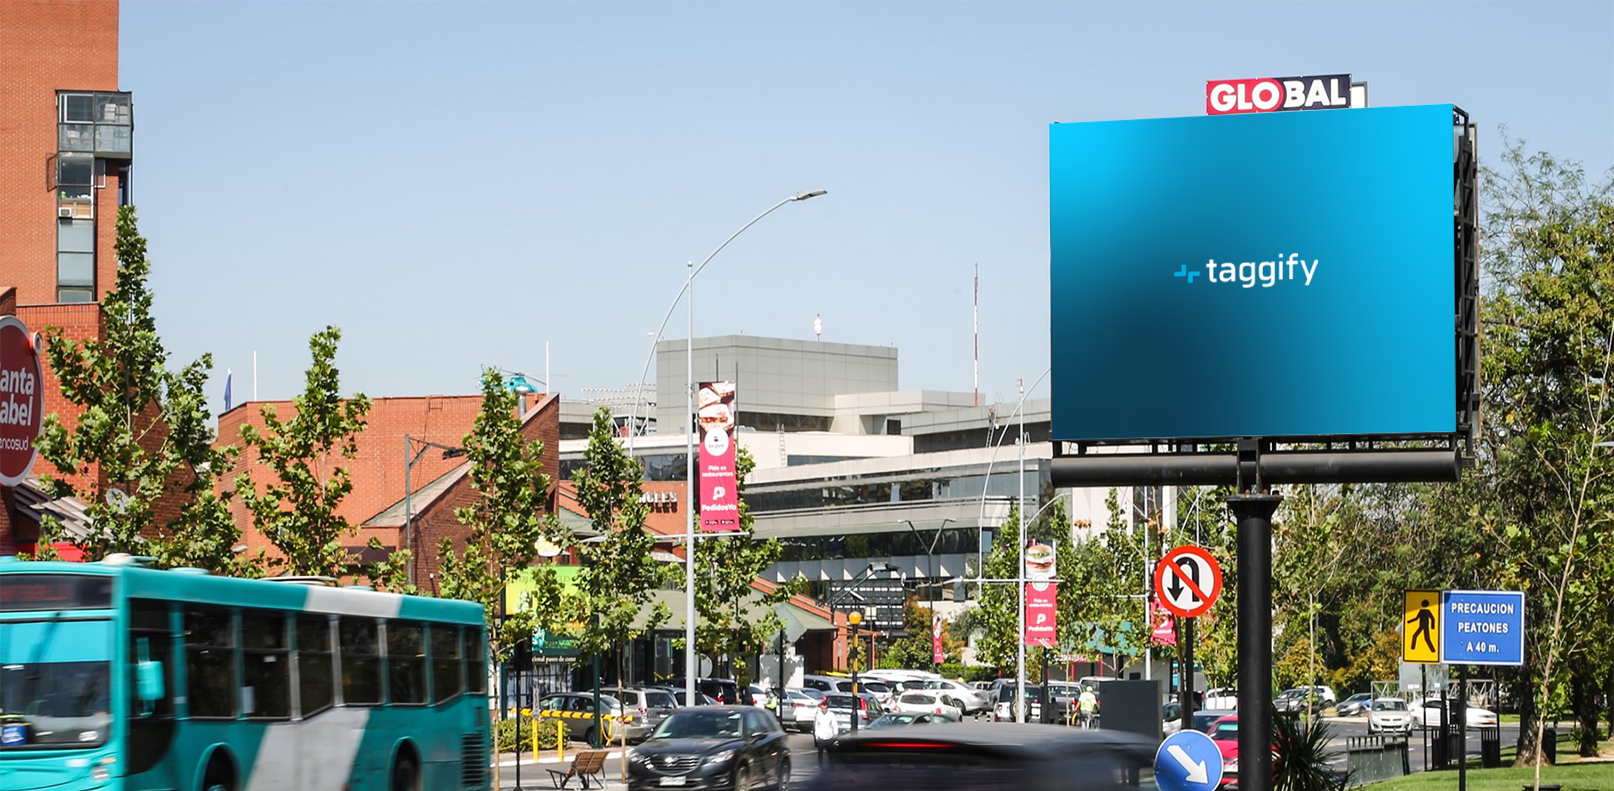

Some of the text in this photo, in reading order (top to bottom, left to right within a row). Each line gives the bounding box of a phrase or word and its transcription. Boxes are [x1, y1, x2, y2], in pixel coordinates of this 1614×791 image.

[1210, 78, 1347, 112] GLOBAL
[1206, 253, 1319, 288] taggify
[0, 367, 35, 396] anta
[0, 393, 33, 426] abel
[1451, 602, 1514, 615] PRECAUCION
[1458, 622, 1509, 634] PEATONES
[1466, 642, 1500, 653] A 40 m.
